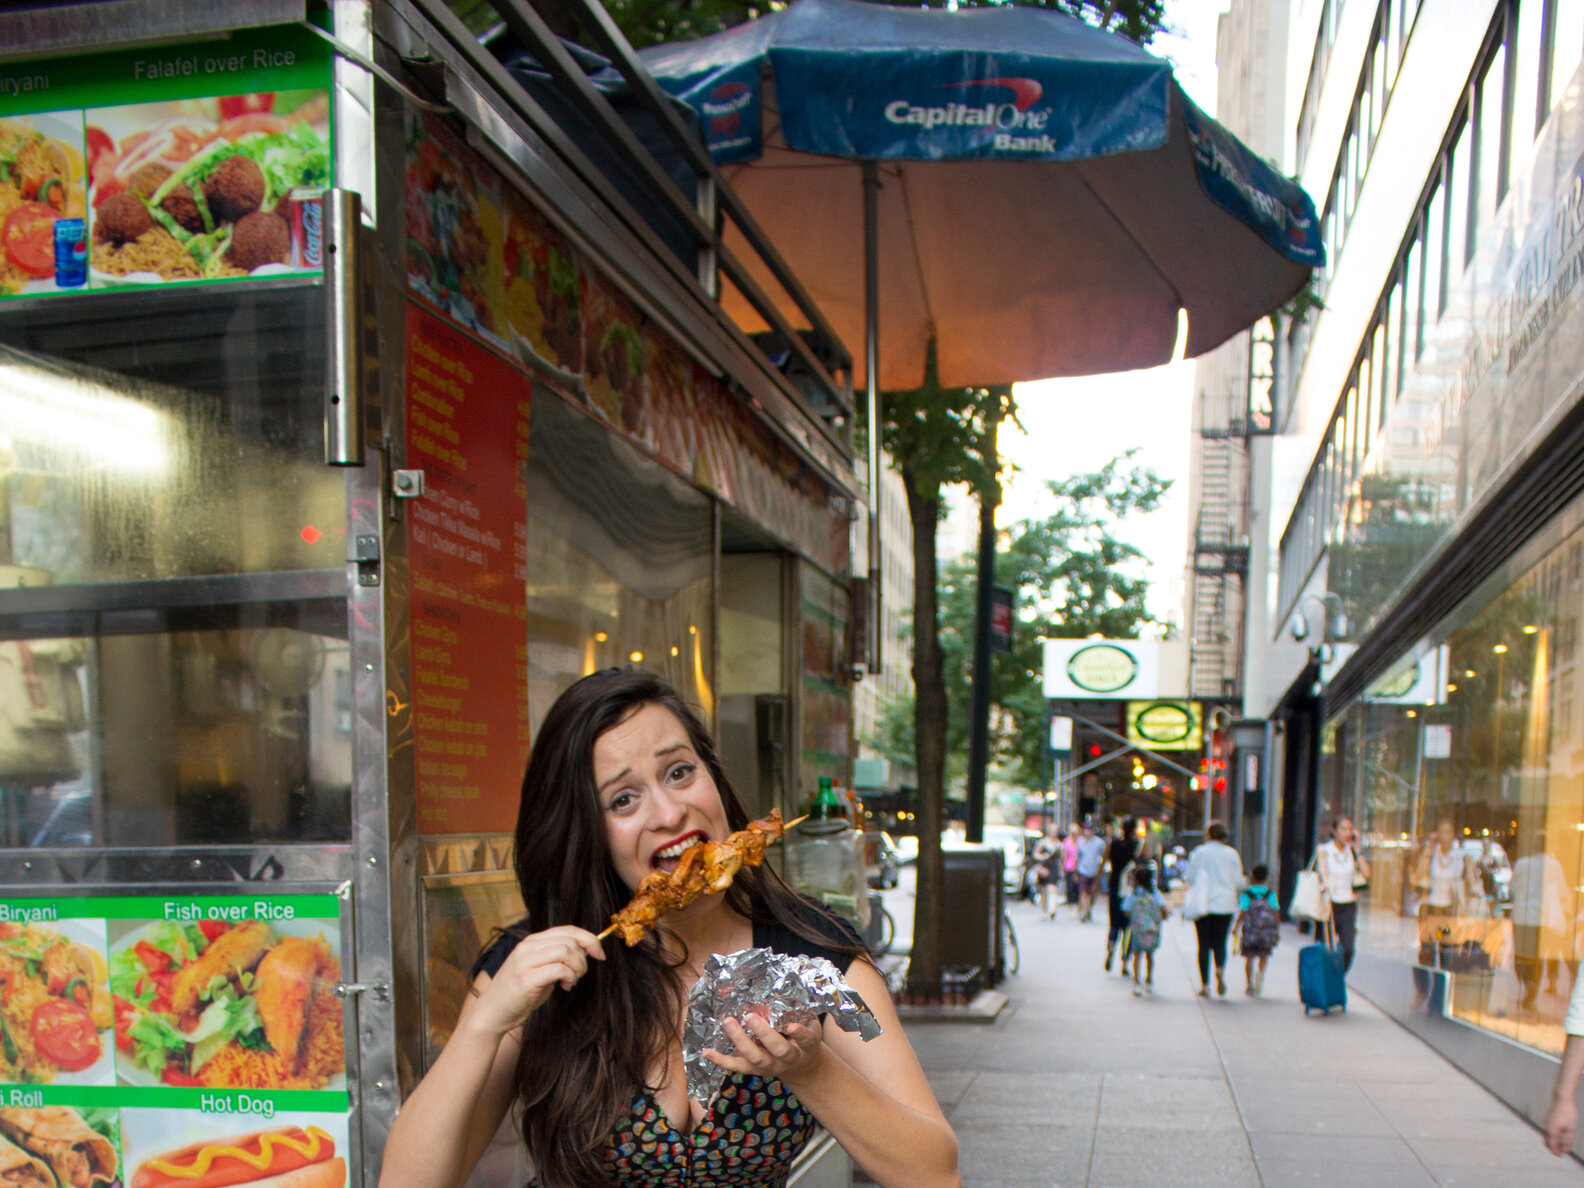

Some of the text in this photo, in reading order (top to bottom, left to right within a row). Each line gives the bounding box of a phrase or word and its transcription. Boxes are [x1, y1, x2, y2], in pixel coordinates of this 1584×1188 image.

[134, 48, 296, 80] Falafel over Rice
[993, 133, 1057, 152] Bank
[0, 903, 57, 926] Biryani
[164, 901, 295, 920] Fish over Rice
[10, 1089, 43, 1107] Roll
[201, 1094, 275, 1118] Hot Dog
